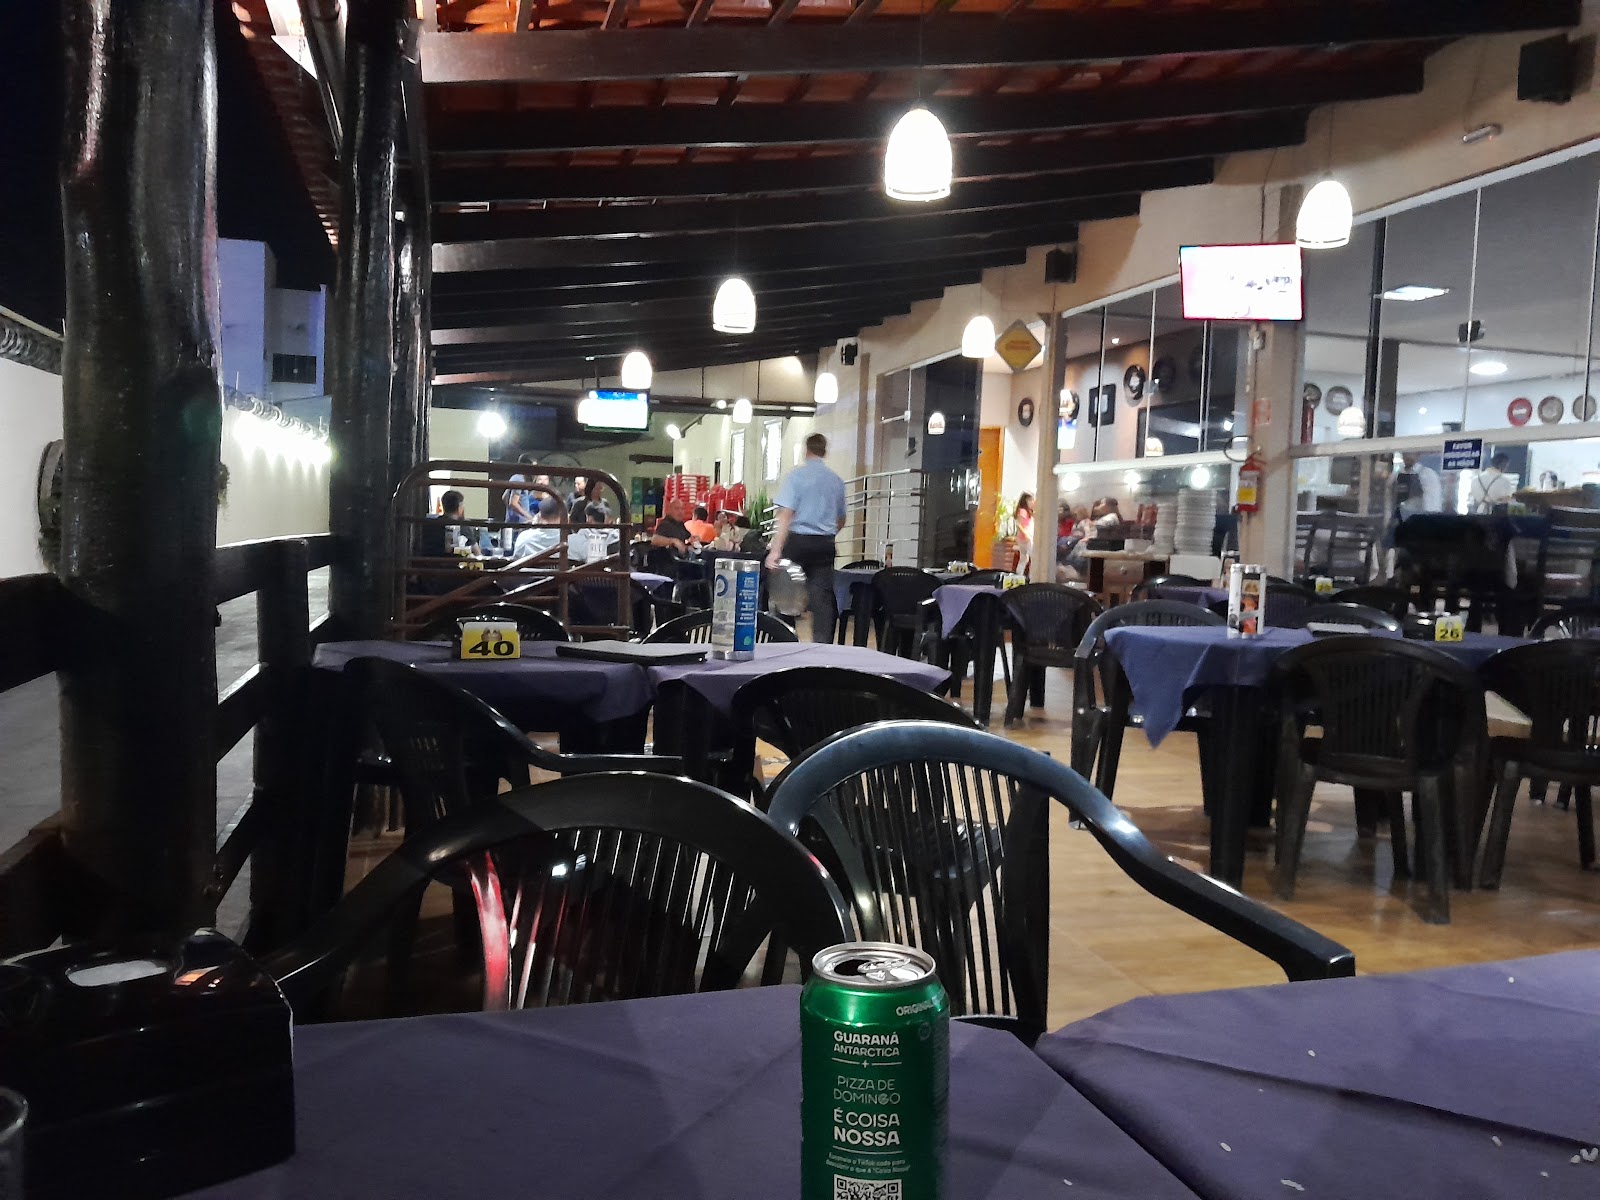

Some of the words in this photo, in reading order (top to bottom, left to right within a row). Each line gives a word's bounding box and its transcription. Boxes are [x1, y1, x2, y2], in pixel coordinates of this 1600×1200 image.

[1440, 628, 1459, 639] 26
[468, 640, 514, 656] 40
[833, 1030, 899, 1045] GUARANÁ
[833, 1043, 900, 1057] ANTARCTICA
[837, 1075, 875, 1090] PIZZA
[877, 1078, 896, 1091] DE
[833, 1088, 901, 1105] DOMINGO
[833, 1106, 844, 1124] É
[845, 1111, 900, 1128] COISA
[833, 1125, 900, 1146] NOSSA
